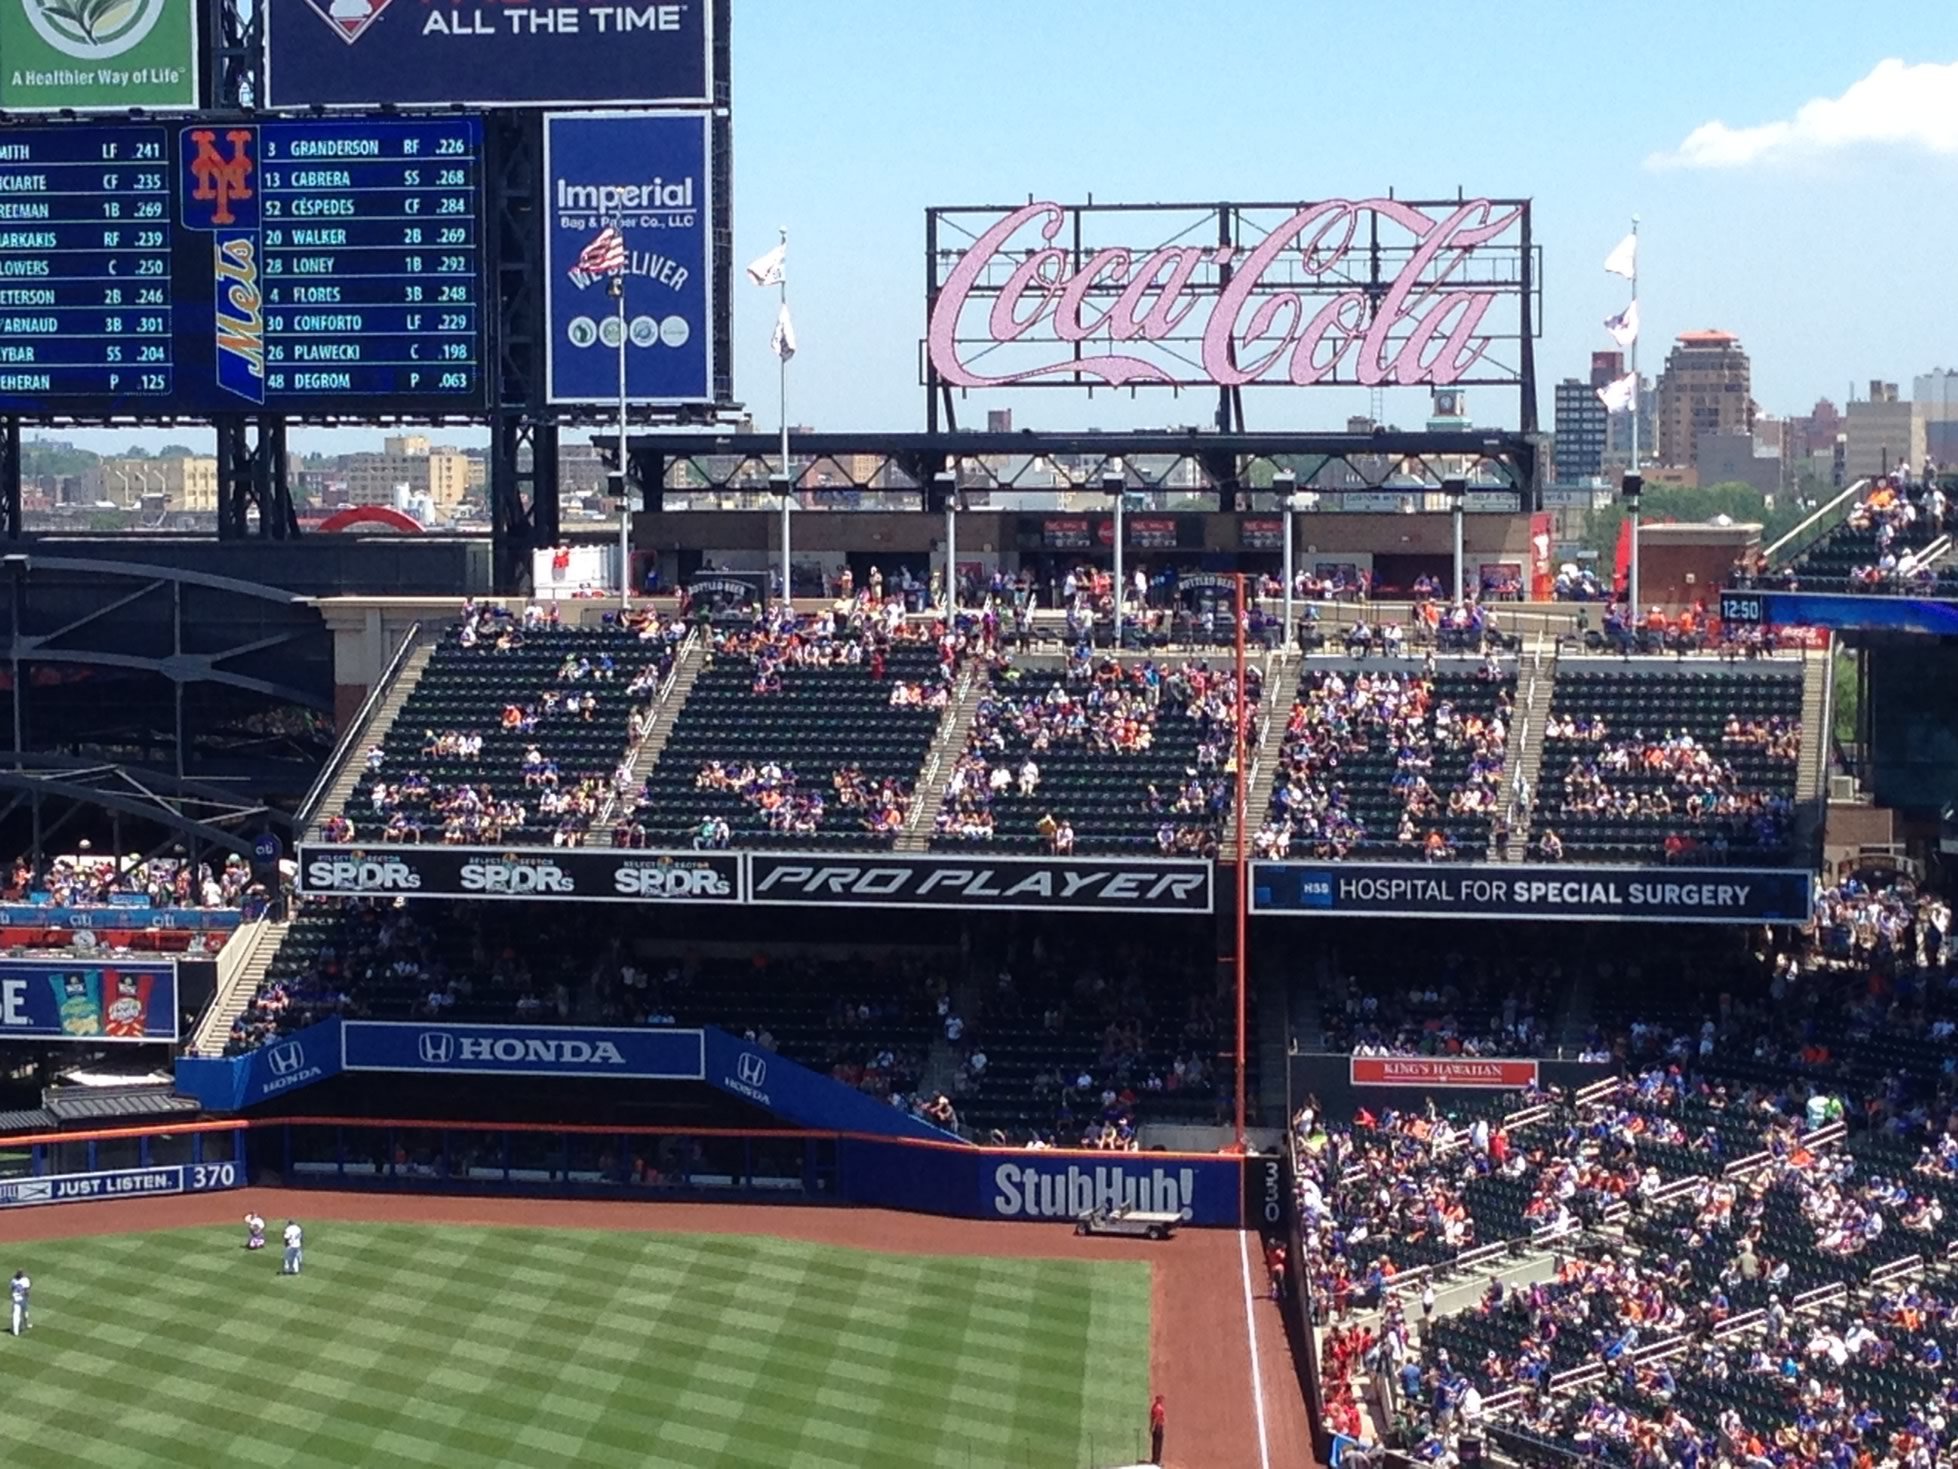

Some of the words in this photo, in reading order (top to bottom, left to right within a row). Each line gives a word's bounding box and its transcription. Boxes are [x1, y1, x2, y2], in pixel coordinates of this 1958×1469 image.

[422, 9, 496, 35] ALL
[503, 8, 580, 34] THE
[589, 5, 681, 32] TIME
[12, 70, 23, 86] A
[25, 69, 95, 86] Healthier
[97, 69, 130, 87] Way
[132, 68, 148, 83] of
[151, 67, 180, 84] Life
[102, 143, 118, 159] LF
[132, 143, 160, 159] .241
[268, 142, 276, 156] 3
[291, 140, 379, 156] GRANDERSON
[403, 139, 420, 155] RF
[435, 139, 465, 154] .226
[103, 174, 119, 189] CF
[133, 174, 161, 189] .235
[265, 172, 281, 187] 13
[291, 171, 351, 187] CABRERA
[404, 170, 420, 185] SS
[435, 170, 465, 185] .268
[557, 176, 693, 212] Imperial
[103, 203, 120, 217] 1B
[133, 202, 162, 217] .269
[265, 201, 281, 215] 52
[404, 199, 420, 214] CF
[436, 198, 465, 214] .284
[560, 216, 586, 231] Bag
[588, 216, 598, 228] &
[668, 214, 694, 227] LLC
[104, 231, 121, 247] RF
[134, 231, 163, 246] .239
[265, 230, 282, 245] 20
[292, 229, 347, 245] WALKER
[404, 228, 422, 243] 2B
[436, 228, 466, 243] .269
[108, 260, 118, 275] C
[135, 260, 163, 274] .250
[265, 259, 283, 273] 28
[293, 257, 334, 273] LONEY
[405, 256, 422, 272] 1B
[437, 256, 466, 271] .292
[104, 289, 122, 304] 2B
[135, 289, 164, 303] .246
[269, 288, 280, 302] 4
[293, 287, 341, 302] FLORES
[404, 286, 423, 301] 3B
[437, 286, 467, 301] .248
[927, 199, 1524, 388] Coca-Cola
[105, 317, 122, 332] 3B
[136, 317, 163, 332] .301
[266, 316, 284, 331] 30
[293, 315, 362, 331] CONFORTO
[406, 314, 422, 330] LF
[437, 314, 467, 330] .229
[106, 346, 122, 361] SS
[136, 346, 165, 361] .204
[267, 346, 284, 360] 26
[294, 345, 360, 360] PLAWECKI
[410, 344, 420, 359] C
[438, 344, 468, 359] .198
[110, 374, 120, 390] P
[137, 374, 166, 389] .125
[267, 374, 285, 389] 48
[294, 373, 351, 389] DEGROM
[410, 373, 420, 388] P
[438, 373, 468, 388] .063
[1723, 600, 1759, 619] 12:50
[756, 866, 913, 893] PRO
[916, 869, 1206, 899] PLAYER
[1339, 878, 1454, 901] HOSPITAL
[1461, 880, 1508, 902] FOR
[1513, 881, 1623, 904] SPECIAL
[1628, 883, 1751, 906] SURGERY
[459, 1037, 627, 1065] HONDA
[1384, 1062, 1430, 1075] KING'S
[1433, 1063, 1502, 1076] HAWAIIAN
[192, 1164, 236, 1188] 370
[57, 1179, 101, 1197] JUST
[994, 1163, 1194, 1220] StubHub!
